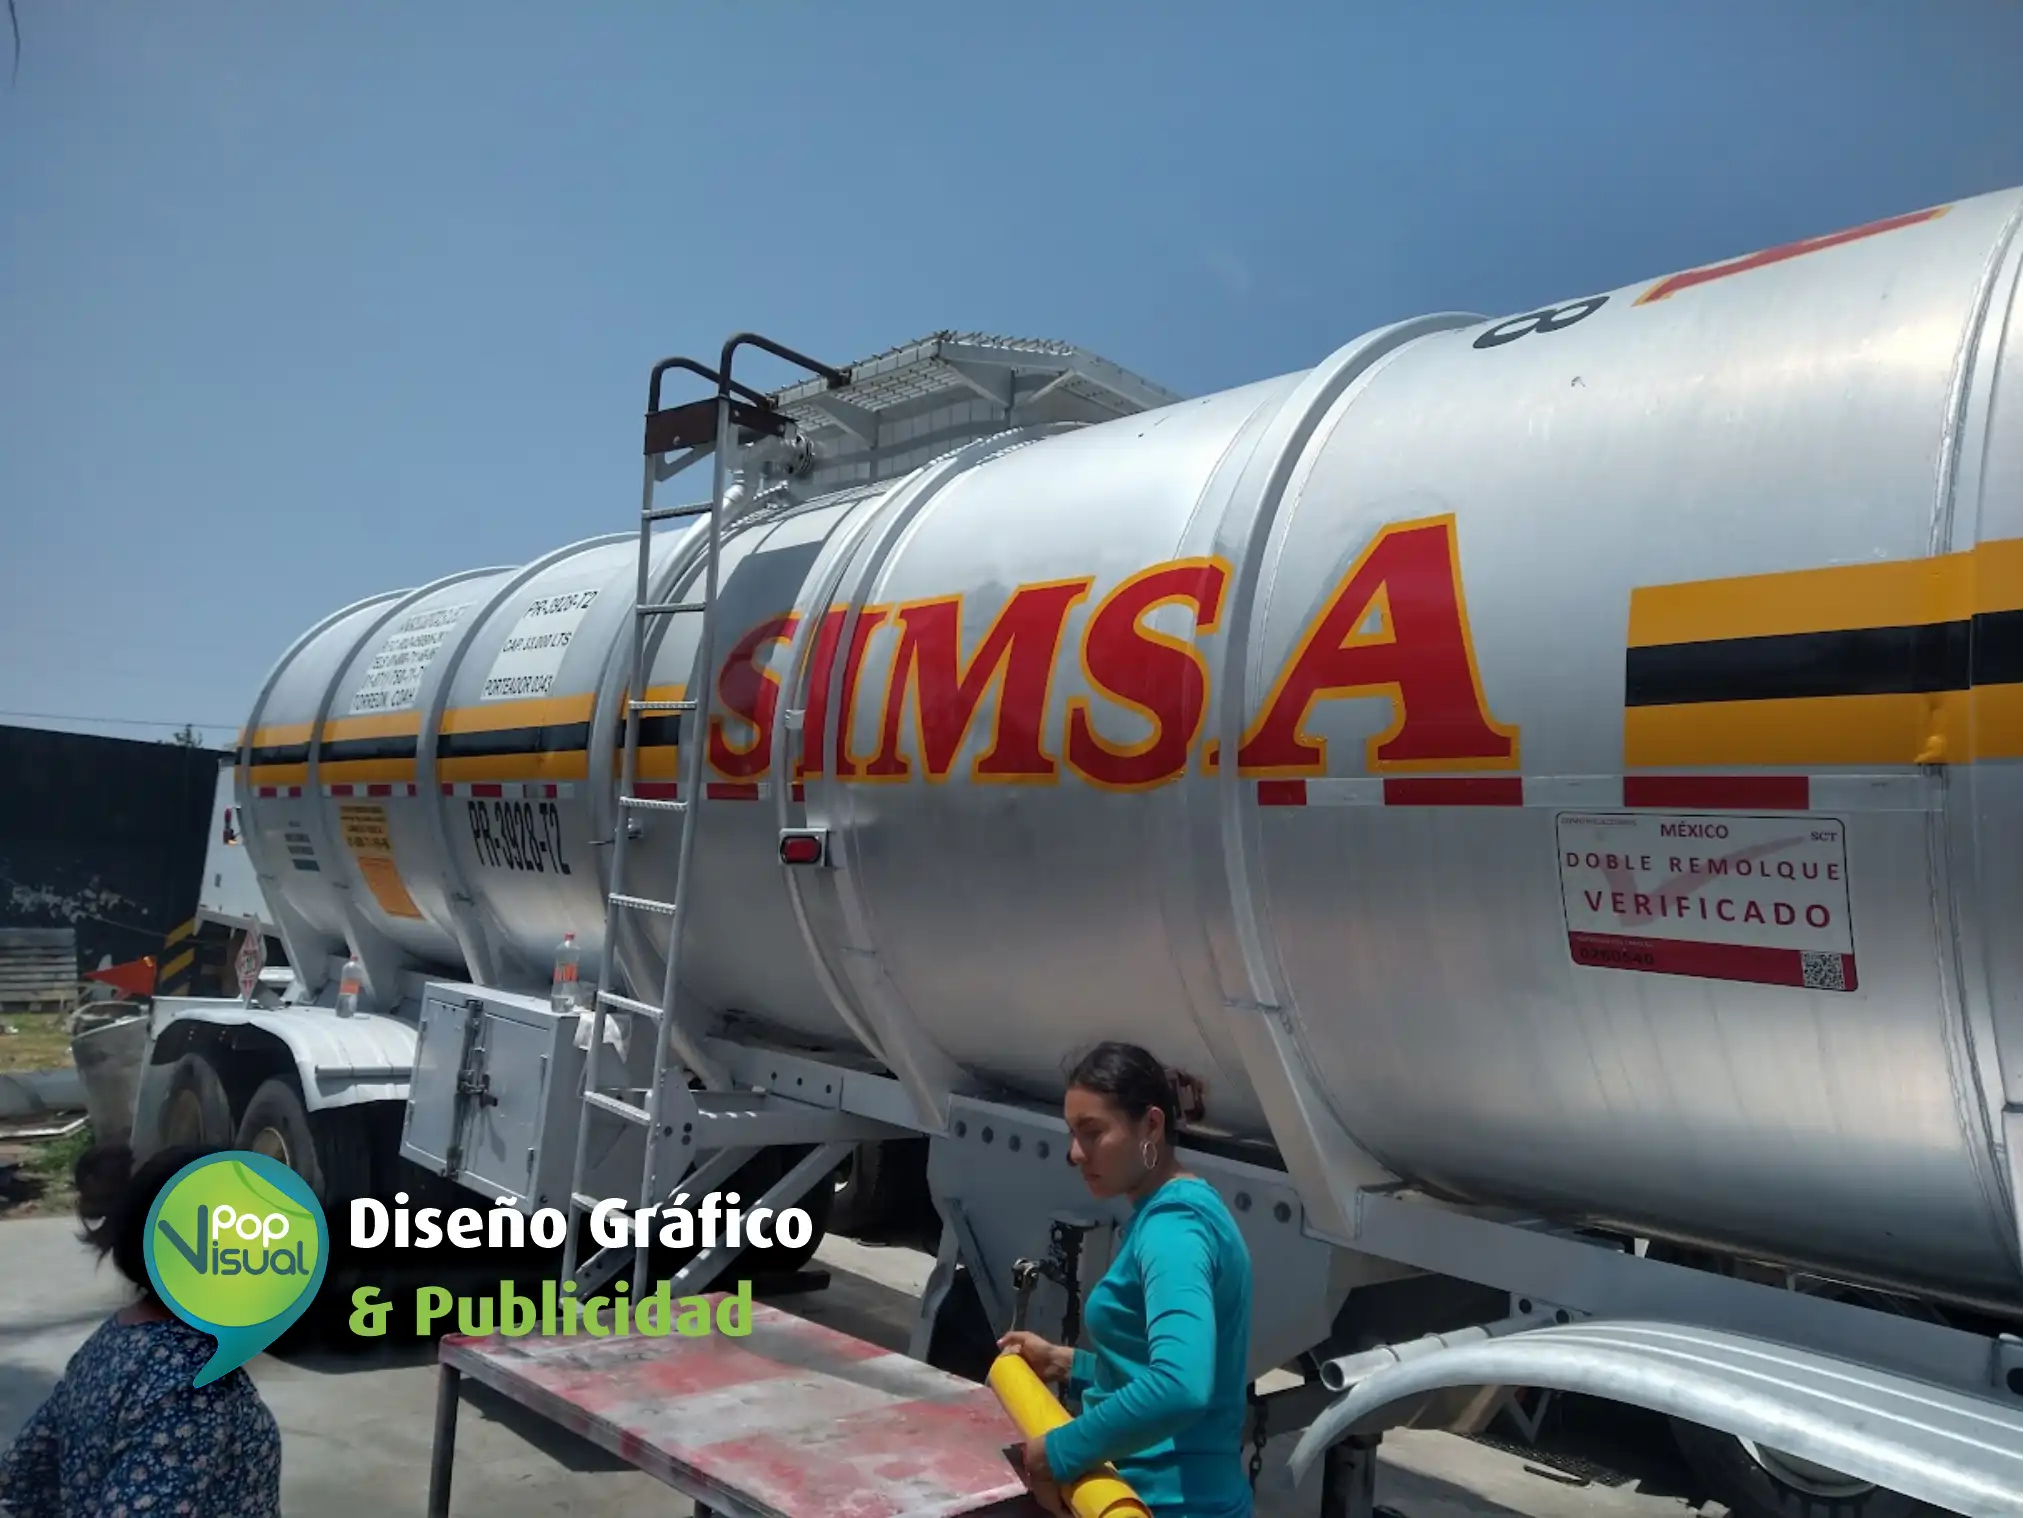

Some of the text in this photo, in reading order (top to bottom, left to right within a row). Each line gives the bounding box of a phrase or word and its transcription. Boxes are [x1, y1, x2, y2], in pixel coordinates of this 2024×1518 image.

[551, 632, 572, 648] LTS
[706, 513, 1520, 795] SIMSA
[482, 676, 532, 696] PORTEADOR
[468, 800, 572, 875] PR-3928-T2
[1660, 820, 1729, 839] MÉXICO
[1810, 831, 1837, 842] SCT
[1566, 852, 1841, 881] DOBLE REMOLQUE
[1584, 890, 1831, 928] VERIFICADO
